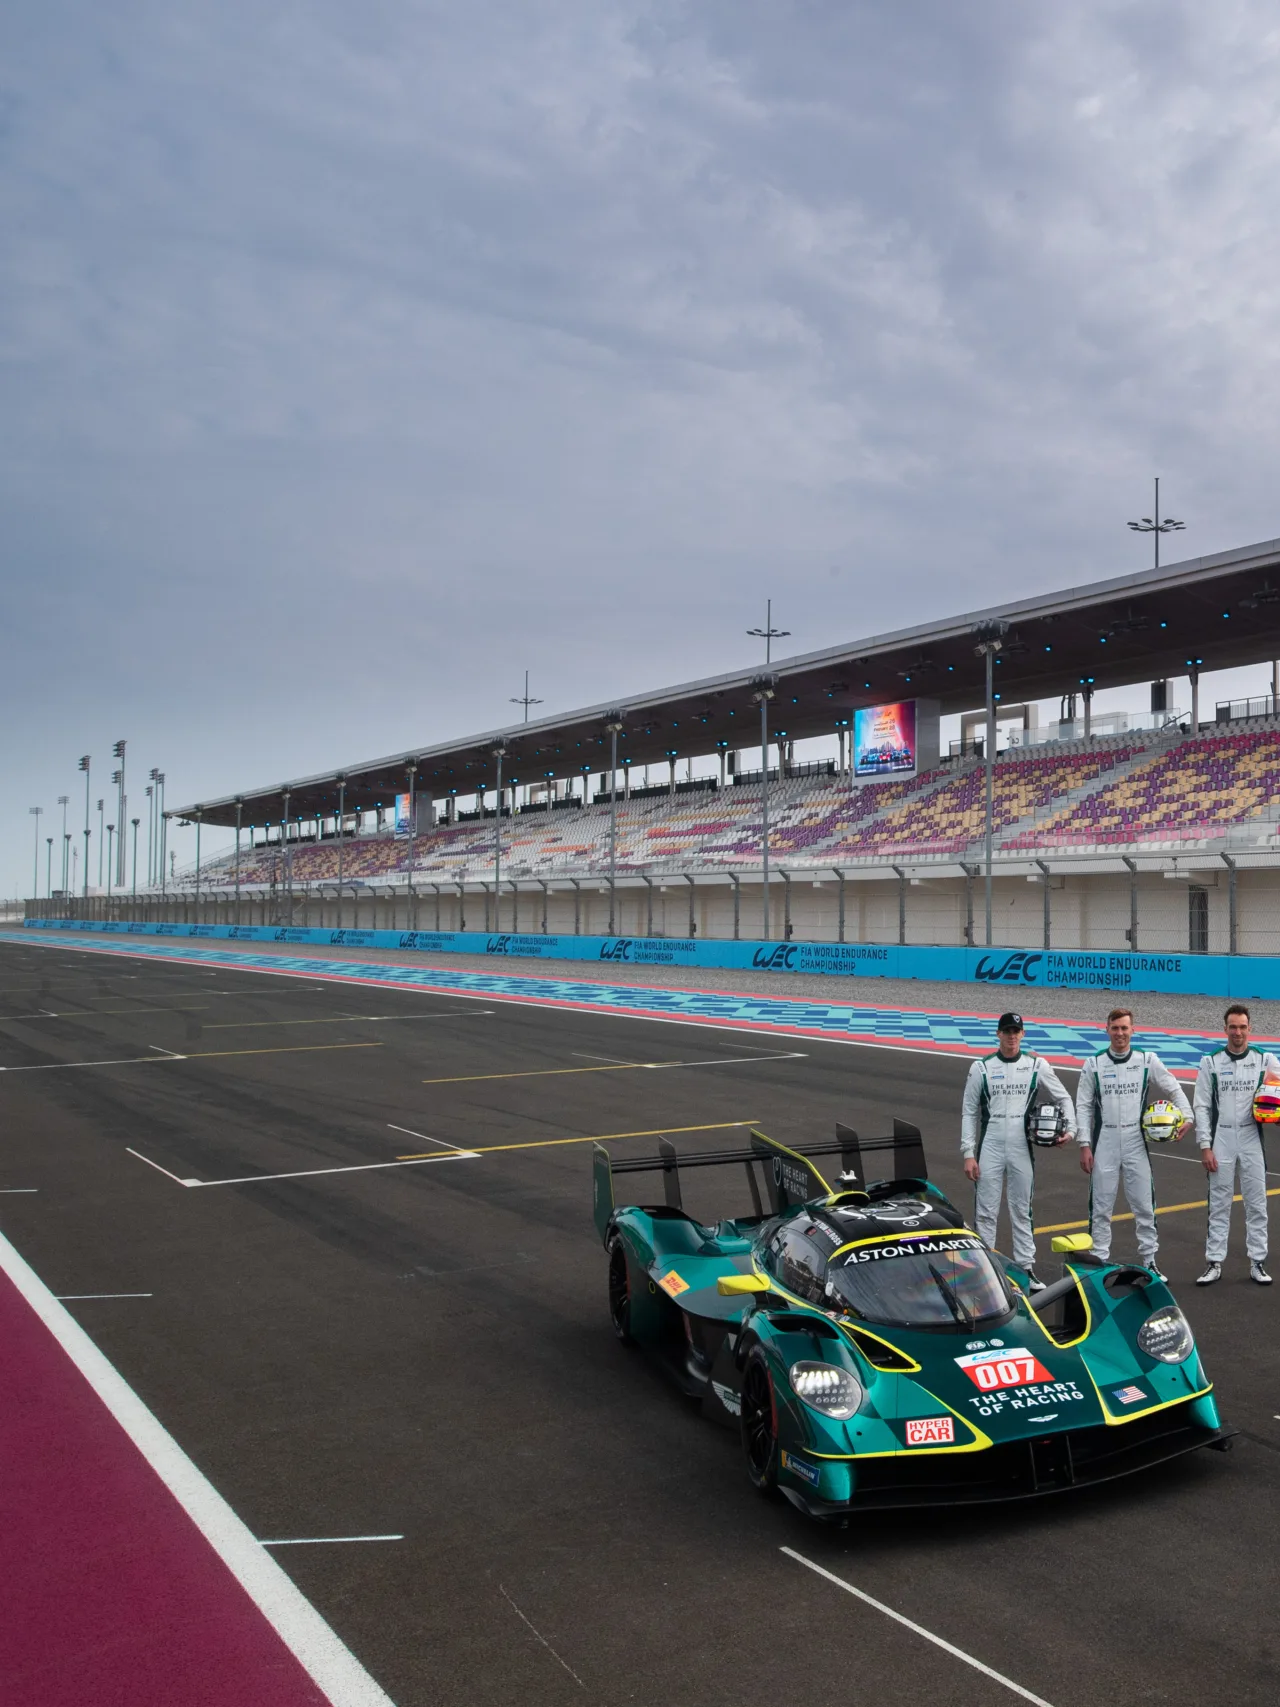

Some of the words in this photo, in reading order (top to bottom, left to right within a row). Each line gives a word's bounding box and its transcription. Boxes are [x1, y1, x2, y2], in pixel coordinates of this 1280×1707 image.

[400, 932, 418, 948] WEC
[487, 936, 511, 953] WEC
[634, 941, 642, 949] FIA
[644, 942, 662, 950] WORLD
[664, 942, 696, 951] ENDURANCE
[600, 940, 632, 960] WEC
[634, 952, 673, 961] CHAMPIONSHIP
[753, 945, 797, 969] WEC
[801, 947, 812, 956] FIA
[814, 948, 839, 958] WORLD
[842, 948, 888, 960] ENDURANCE
[800, 960, 855, 971] CHAMPIONSHIP
[975, 952, 1042, 981] WEC
[1047, 956, 1064, 967] FIA
[1067, 956, 1106, 969] WORLD
[1110, 957, 1181, 972] ENDURANCE
[1047, 970, 1131, 987] CHAMPIONSHIP
[793, 1168, 807, 1185] HEART
[790, 1181, 807, 1199] RACING
[844, 1245, 915, 1266] ASTON
[919, 1238, 986, 1253] MARTIN
[975, 1359, 1035, 1389] 007
[969, 1392, 1010, 1407] THE
[1014, 1382, 1078, 1398] HEART
[979, 1403, 1004, 1416] OF
[1011, 1391, 1084, 1409] RACING
[910, 1420, 949, 1430] HYPER
[910, 1428, 950, 1442] CAR
